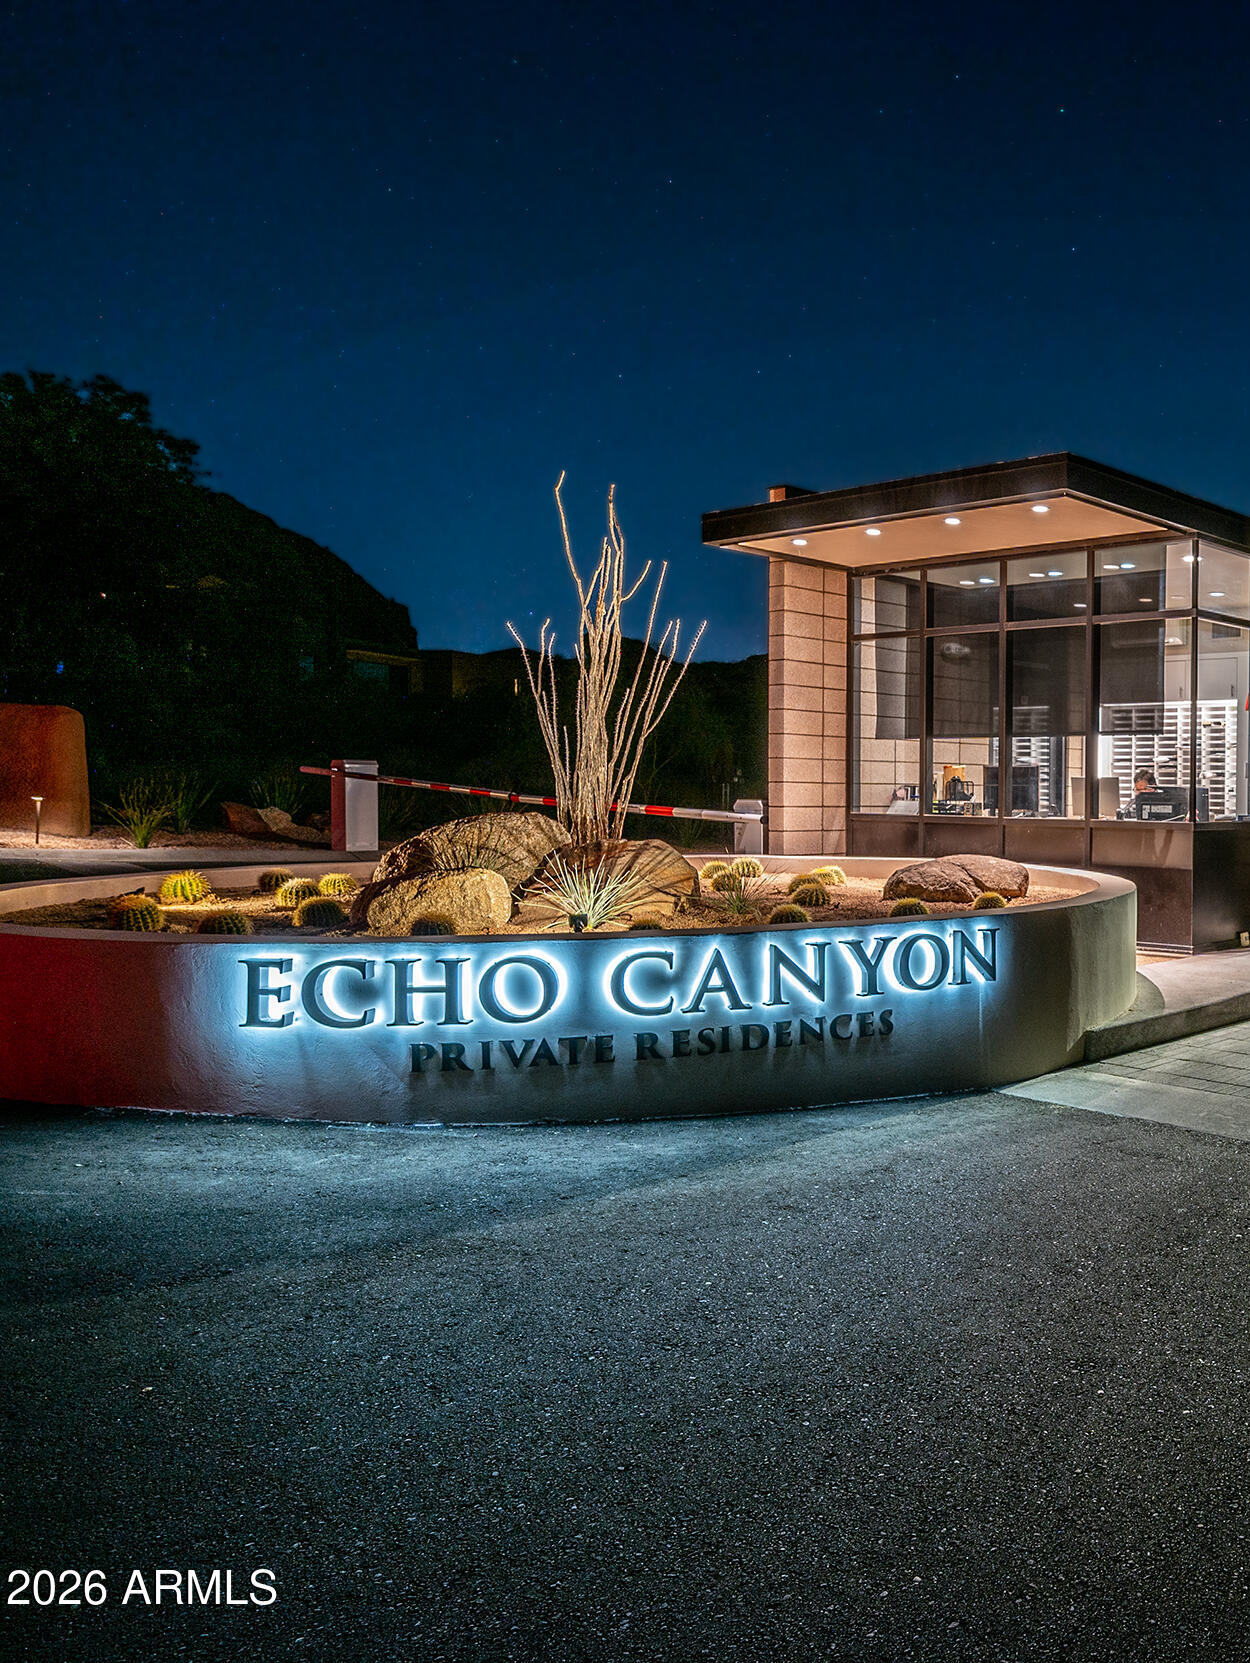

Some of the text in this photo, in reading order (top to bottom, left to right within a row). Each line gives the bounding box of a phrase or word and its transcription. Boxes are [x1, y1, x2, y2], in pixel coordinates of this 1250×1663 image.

[238, 927, 1000, 1029] ECHO CANYON
[409, 1009, 895, 1073] PRIVATE RESIDENCES
